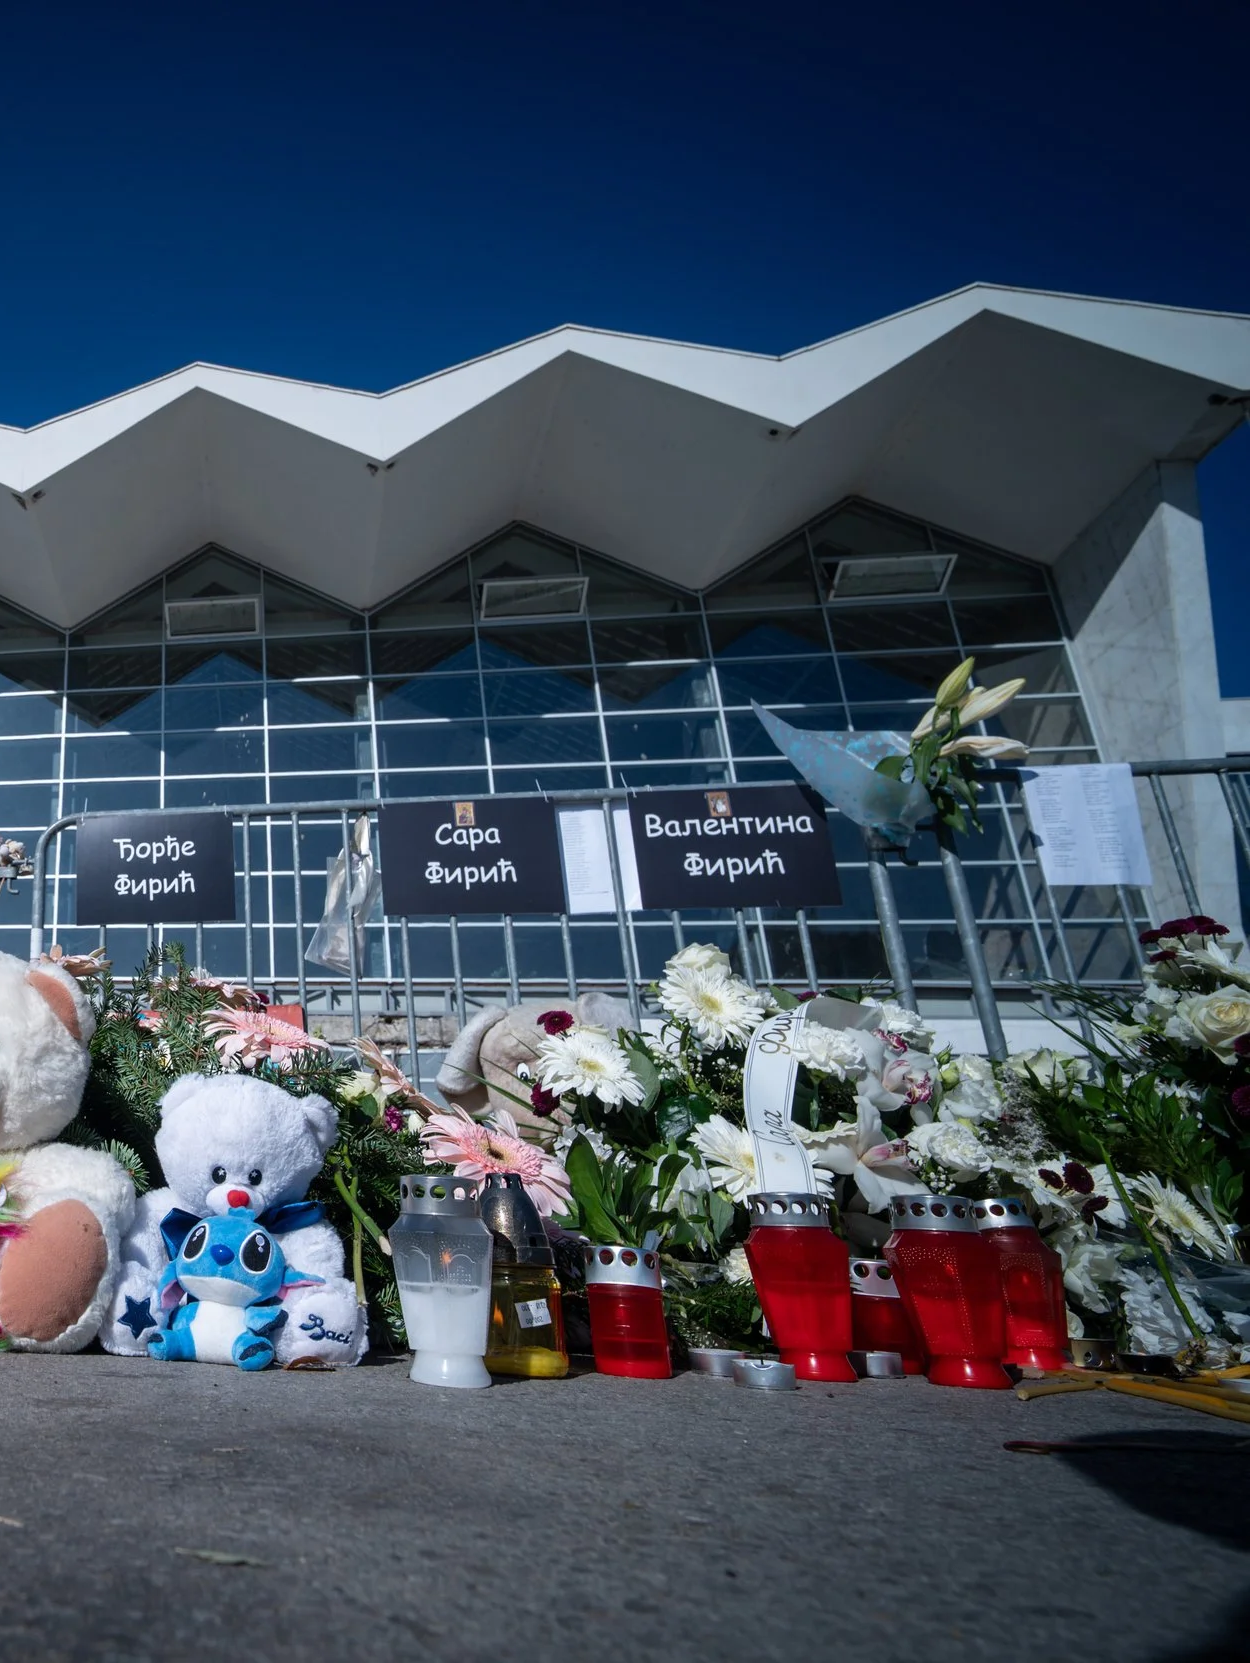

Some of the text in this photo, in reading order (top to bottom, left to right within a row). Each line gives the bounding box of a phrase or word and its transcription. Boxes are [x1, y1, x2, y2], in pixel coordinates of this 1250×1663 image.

[435, 822, 502, 852] Сара
[645, 813, 814, 838] Валентина
[113, 835, 197, 865] Ђорђе
[683, 848, 786, 883] Фирић
[113, 869, 196, 901] Фирић
[425, 857, 518, 891] Фирић
[299, 1313, 353, 1345] Baci
